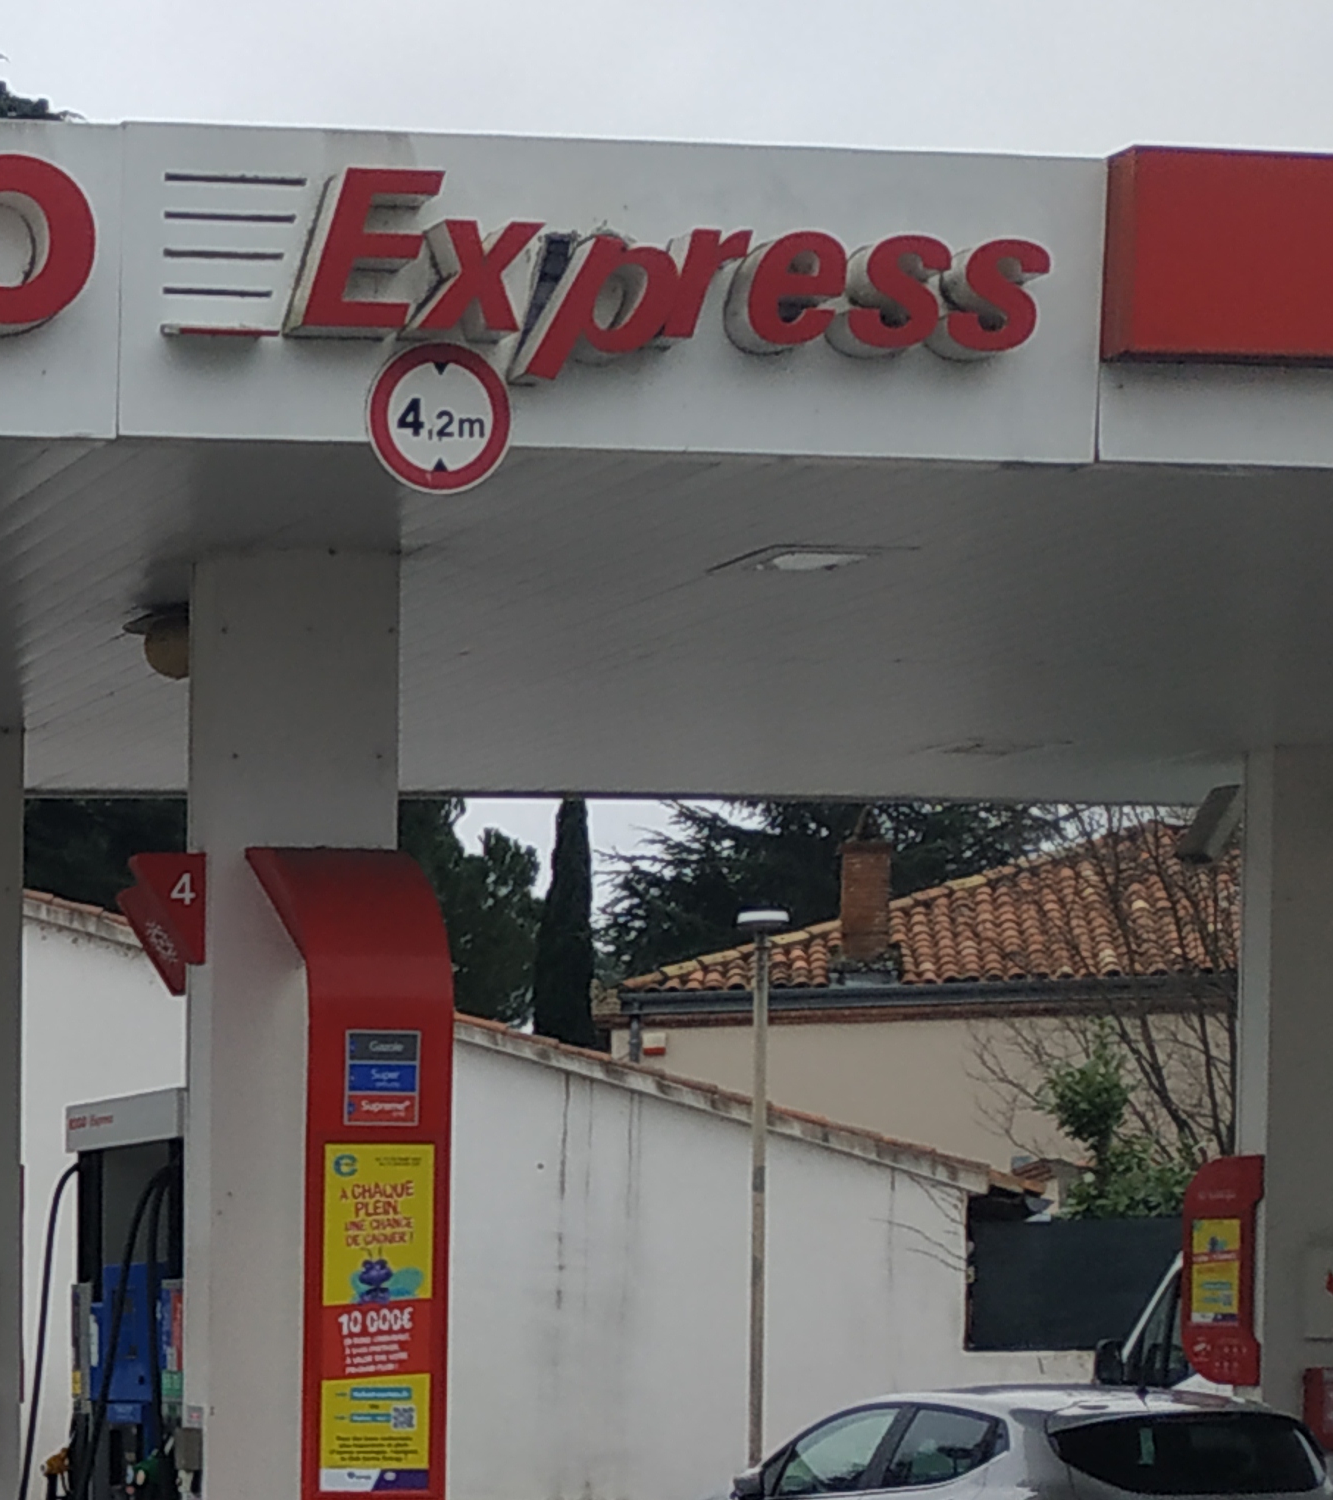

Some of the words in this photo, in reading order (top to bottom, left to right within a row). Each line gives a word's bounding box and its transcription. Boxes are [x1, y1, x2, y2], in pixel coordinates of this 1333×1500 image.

[288, 167, 1051, 382] Express
[397, 398, 485, 441] 4,2m
[170, 872, 196, 906] 4
[352, 1181, 414, 1199] CHAQUE
[338, 1310, 362, 1335] 10
